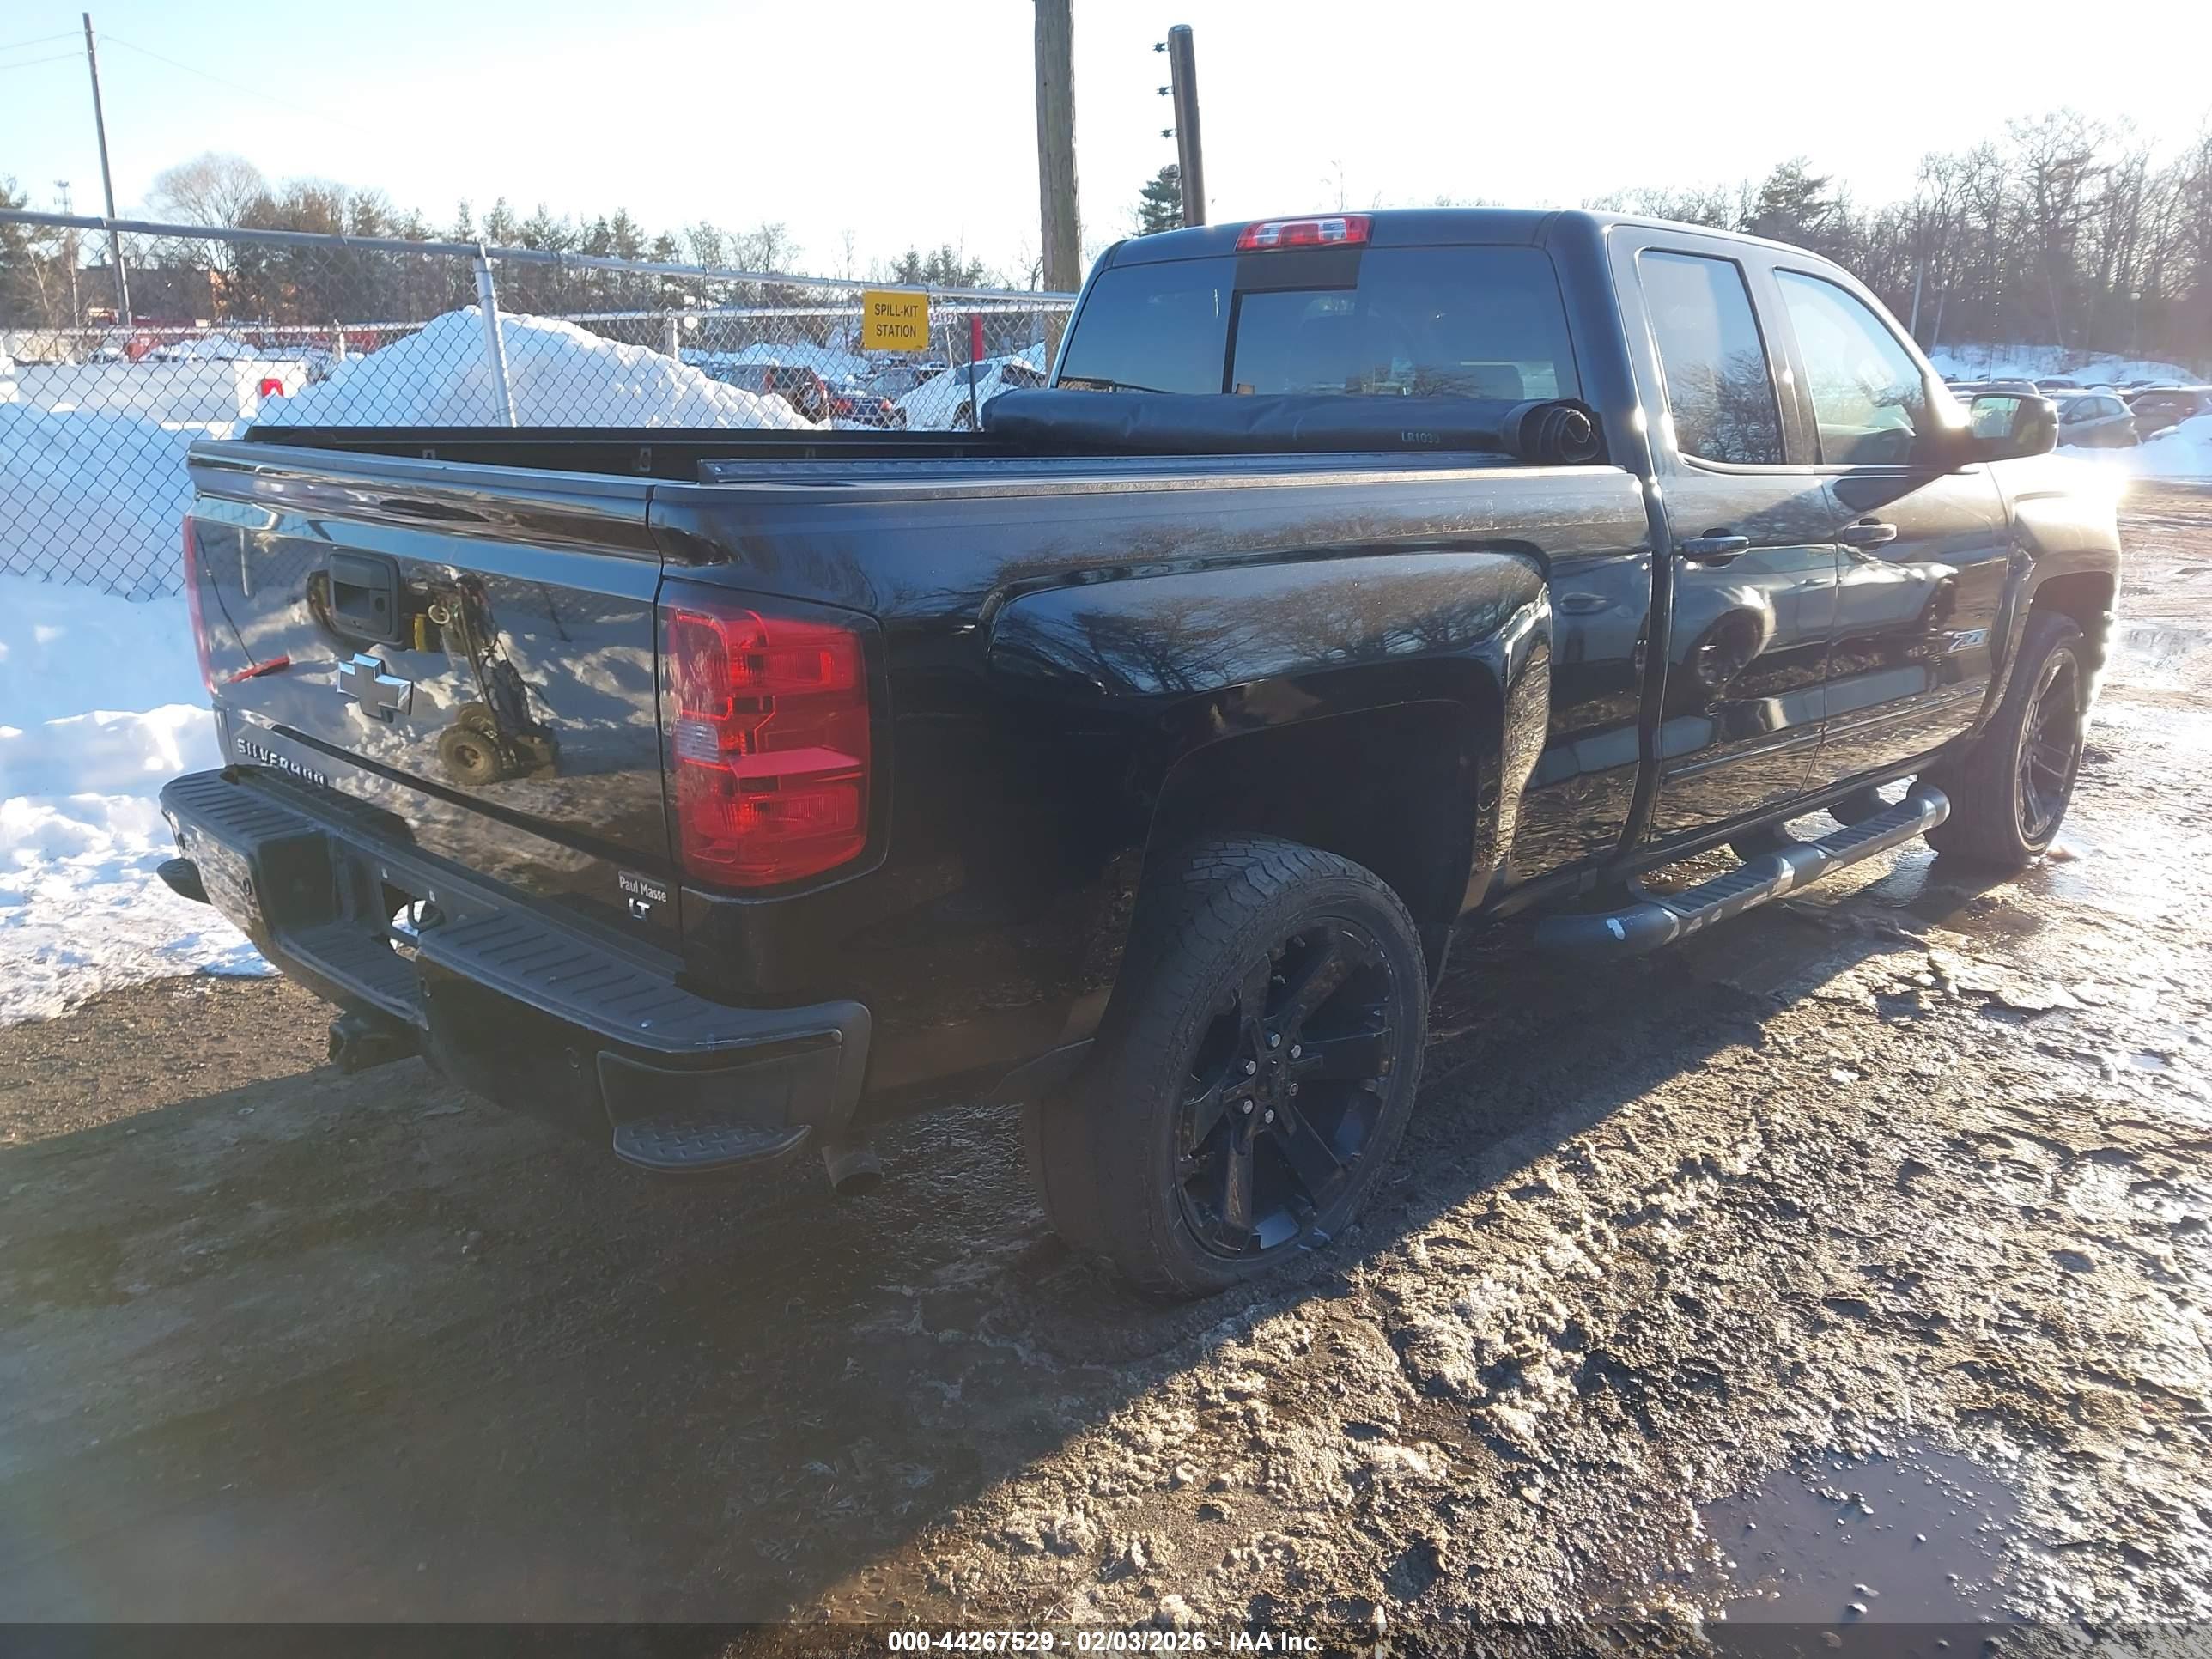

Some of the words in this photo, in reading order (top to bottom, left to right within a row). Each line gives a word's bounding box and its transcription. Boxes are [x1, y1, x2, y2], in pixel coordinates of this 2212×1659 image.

[874, 303, 918, 317] SPILL-KIT
[876, 324, 916, 337] STATION
[619, 876, 638, 893] Paul
[640, 882, 667, 902] Masse
[629, 897, 650, 919] LT
